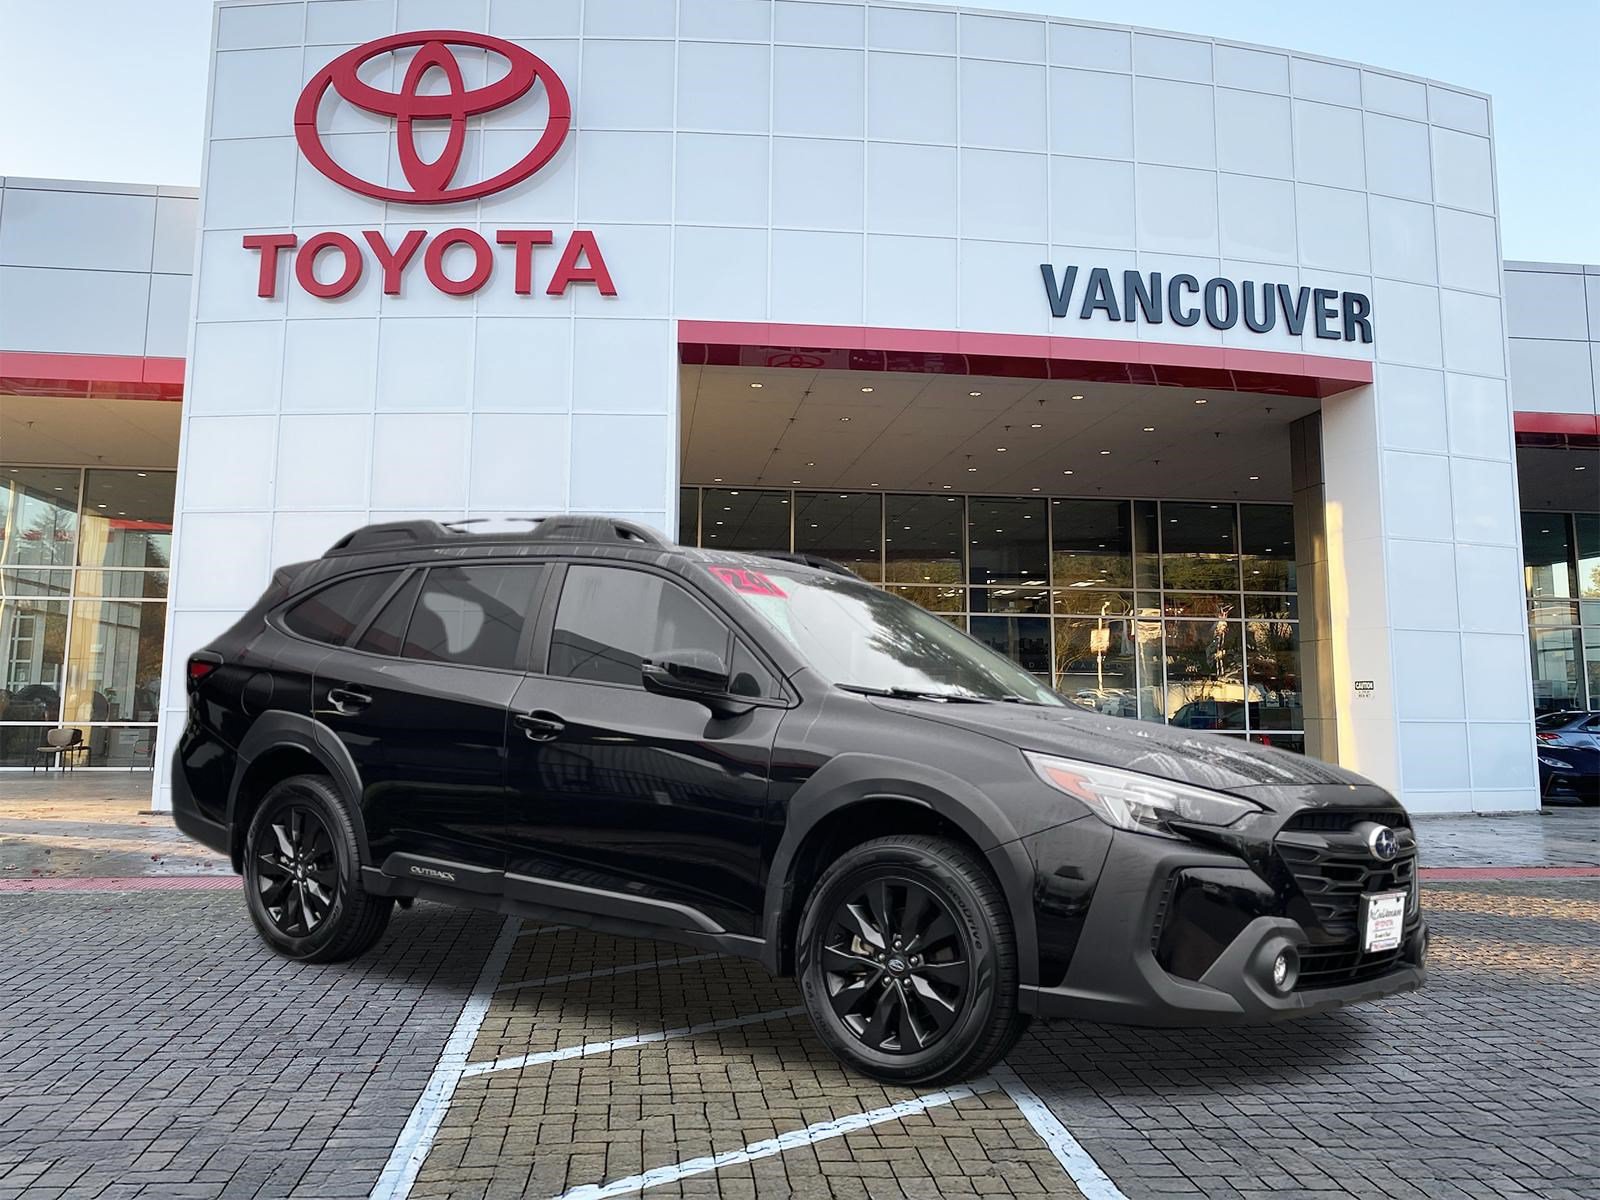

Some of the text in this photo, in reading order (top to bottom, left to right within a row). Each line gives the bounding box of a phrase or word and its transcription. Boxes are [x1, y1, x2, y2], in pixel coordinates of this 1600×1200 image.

[243, 228, 617, 299] TOYOTA
[1040, 264, 1373, 343] VANCOUVER
[410, 865, 456, 881] OUTBACK
